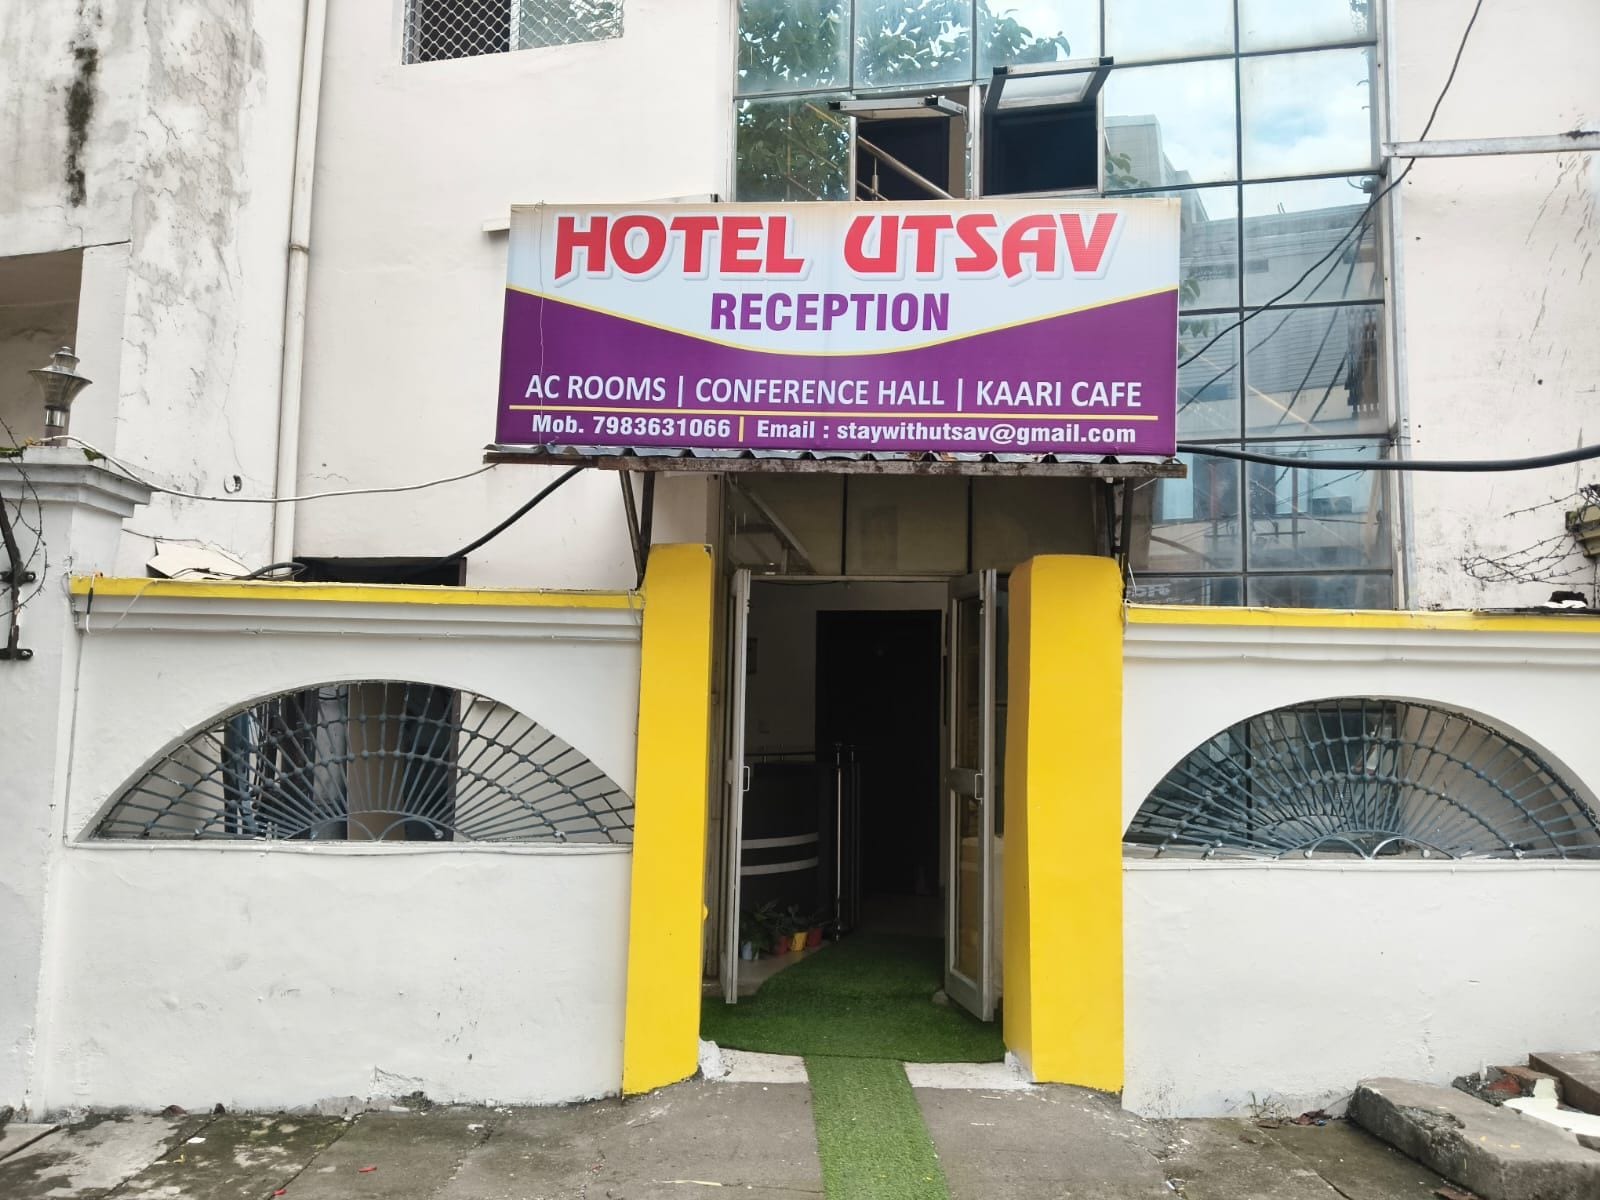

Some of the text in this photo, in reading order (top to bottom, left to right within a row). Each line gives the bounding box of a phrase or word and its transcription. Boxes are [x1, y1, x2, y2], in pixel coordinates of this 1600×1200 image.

[554, 213, 1118, 280] HOTEL UTSAV
[711, 292, 950, 331] RECEPTION
[525, 374, 560, 399] AC
[567, 375, 667, 401] ROOMS
[695, 378, 869, 405] CONFERENCE
[878, 380, 945, 405] HALL
[976, 380, 1062, 407] KAARI
[1071, 381, 1142, 407] CAFE
[532, 414, 584, 434] Mob.
[592, 416, 731, 438] 7983631066
[757, 420, 815, 438] Email
[837, 422, 1136, 445] staywithutsav@gmail.com
